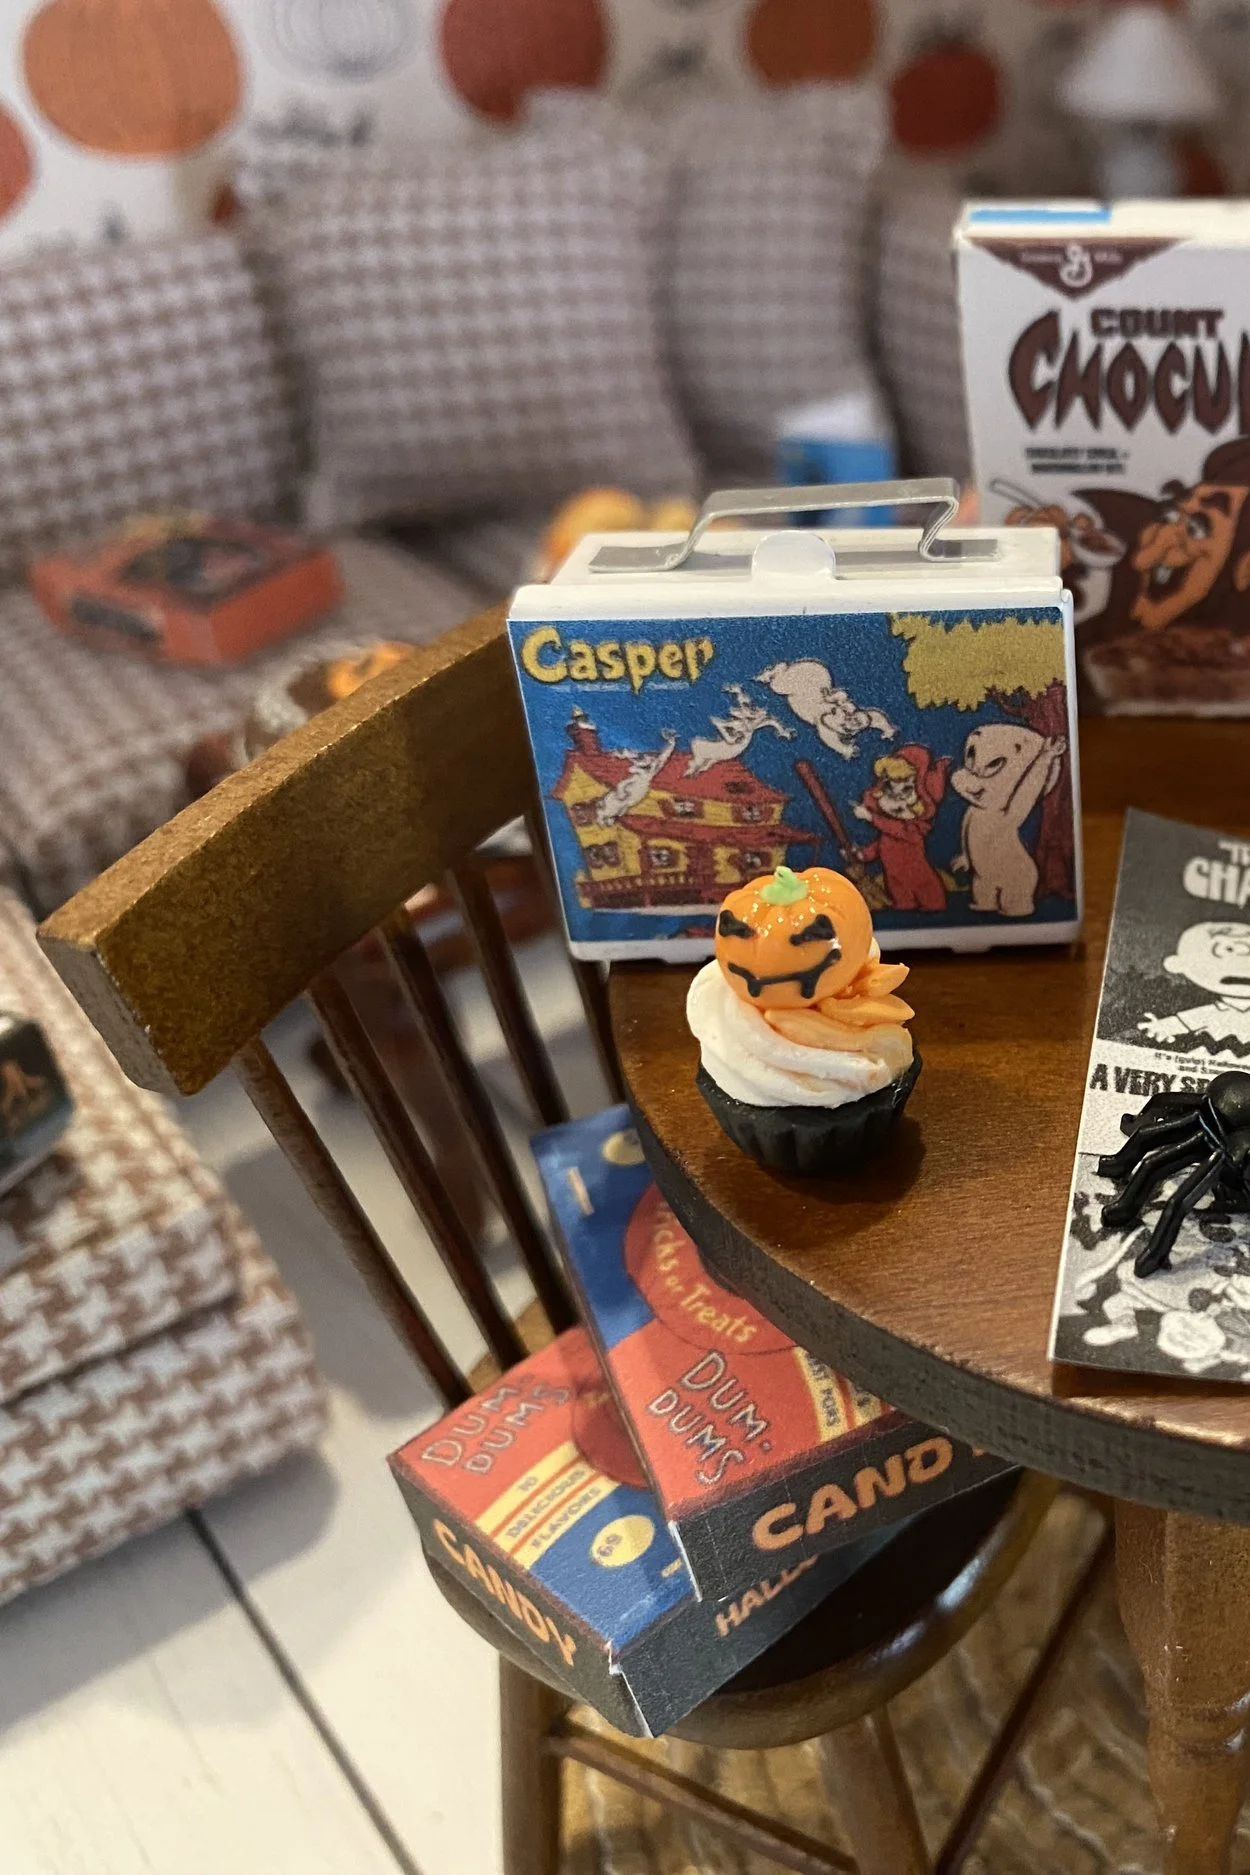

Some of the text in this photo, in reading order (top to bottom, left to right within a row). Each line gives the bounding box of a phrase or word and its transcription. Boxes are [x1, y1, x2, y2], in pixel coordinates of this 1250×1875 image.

[1090, 307, 1224, 340] COUNT
[521, 626, 715, 693] Casper
[1090, 1064, 1108, 1092] A
[1114, 1066, 1177, 1098] VERY
[679, 1283, 758, 1343] Treats
[463, 1382, 570, 1476] DUMS
[647, 1389, 745, 1487] DUMS
[505, 1468, 587, 1540] DELICIOUS
[531, 1486, 602, 1550] FLAVORS
[752, 1436, 984, 1551] CAND
[431, 1518, 577, 1667] CANDY
